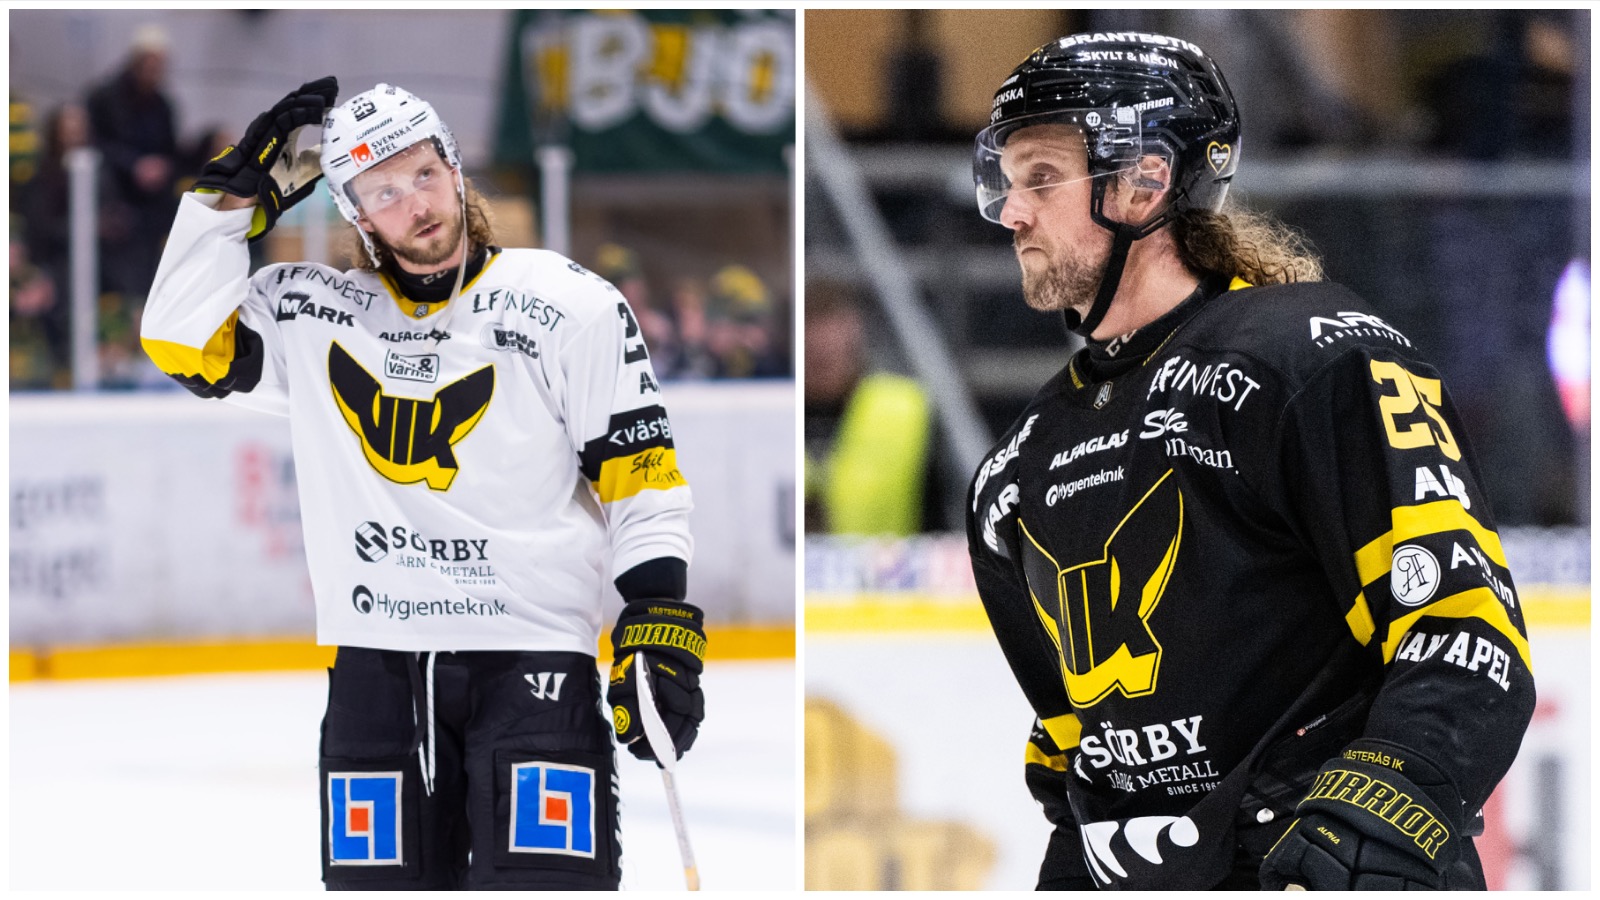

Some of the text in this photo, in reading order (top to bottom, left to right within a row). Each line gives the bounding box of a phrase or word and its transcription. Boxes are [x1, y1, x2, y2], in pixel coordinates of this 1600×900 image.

[1082, 51, 1180, 70] SKYLT & NEON
[371, 126, 412, 150] SVENSKA
[375, 142, 398, 158] SPEL
[276, 291, 355, 327] MARK
[1369, 359, 1462, 463] 25
[1049, 429, 1130, 470] ALFAGLAS
[1056, 465, 1125, 501] Hygienteknik
[391, 525, 489, 562] SÖRBY
[440, 565, 495, 577] METALL
[376, 592, 511, 621] Hygienteknik
[1080, 715, 1207, 769] SÖRBY
[1136, 760, 1219, 789] METALL
[1343, 750, 1405, 772] VÄSTERÅS IK
[1166, 784, 1199, 796] SINCE
[1316, 825, 1341, 845] ALPHA
